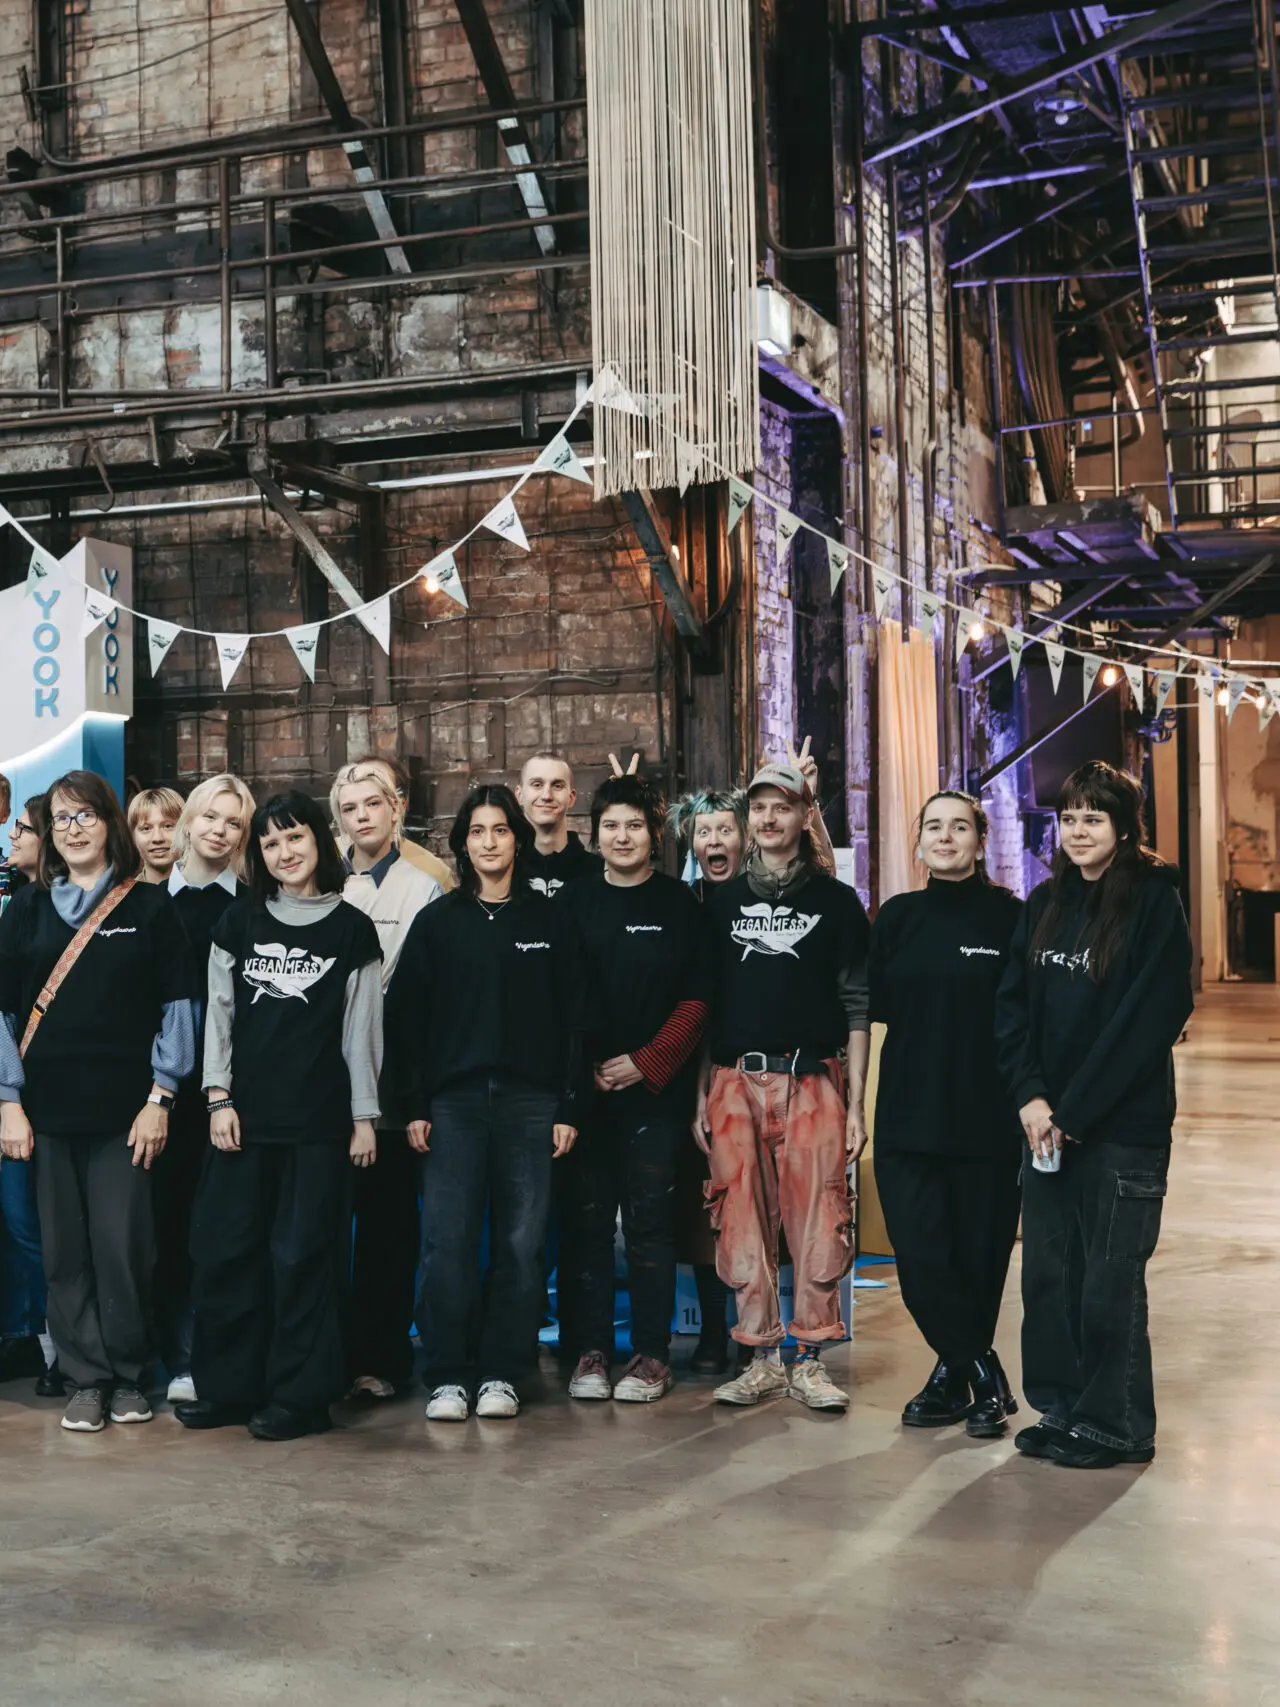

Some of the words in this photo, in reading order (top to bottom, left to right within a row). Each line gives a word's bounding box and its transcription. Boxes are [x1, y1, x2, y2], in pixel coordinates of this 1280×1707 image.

[102, 567, 119, 696] YOOK
[32, 590, 61, 717] YOOK
[731, 918, 805, 932] VEGANMESS
[244, 958, 320, 975] VEGANMESS
[682, 1307, 701, 1326] 1L
